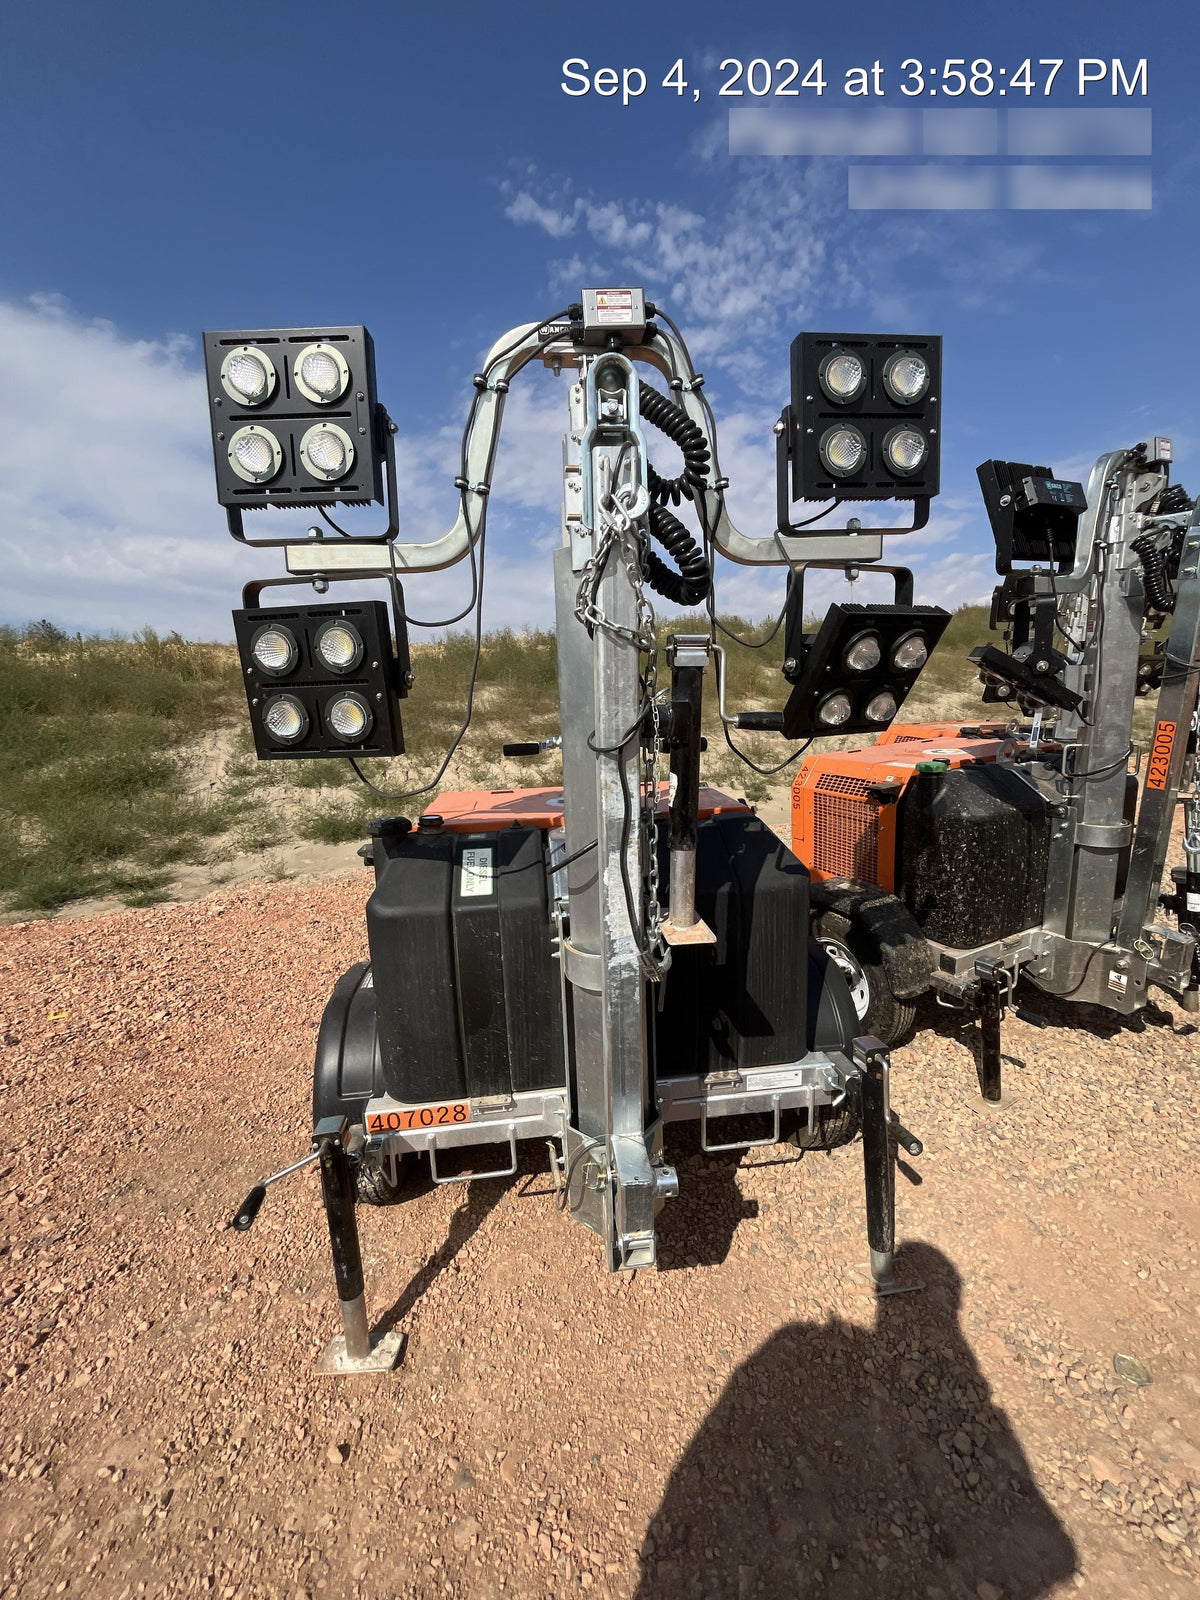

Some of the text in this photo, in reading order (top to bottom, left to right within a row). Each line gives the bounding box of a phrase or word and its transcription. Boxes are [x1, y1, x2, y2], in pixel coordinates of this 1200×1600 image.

[1149, 723, 1175, 788] 423005
[793, 766, 809, 810] 423005
[465, 872, 475, 893] ONLY
[479, 857, 488, 885] DIESEL
[370, 1104, 467, 1131] 407028
